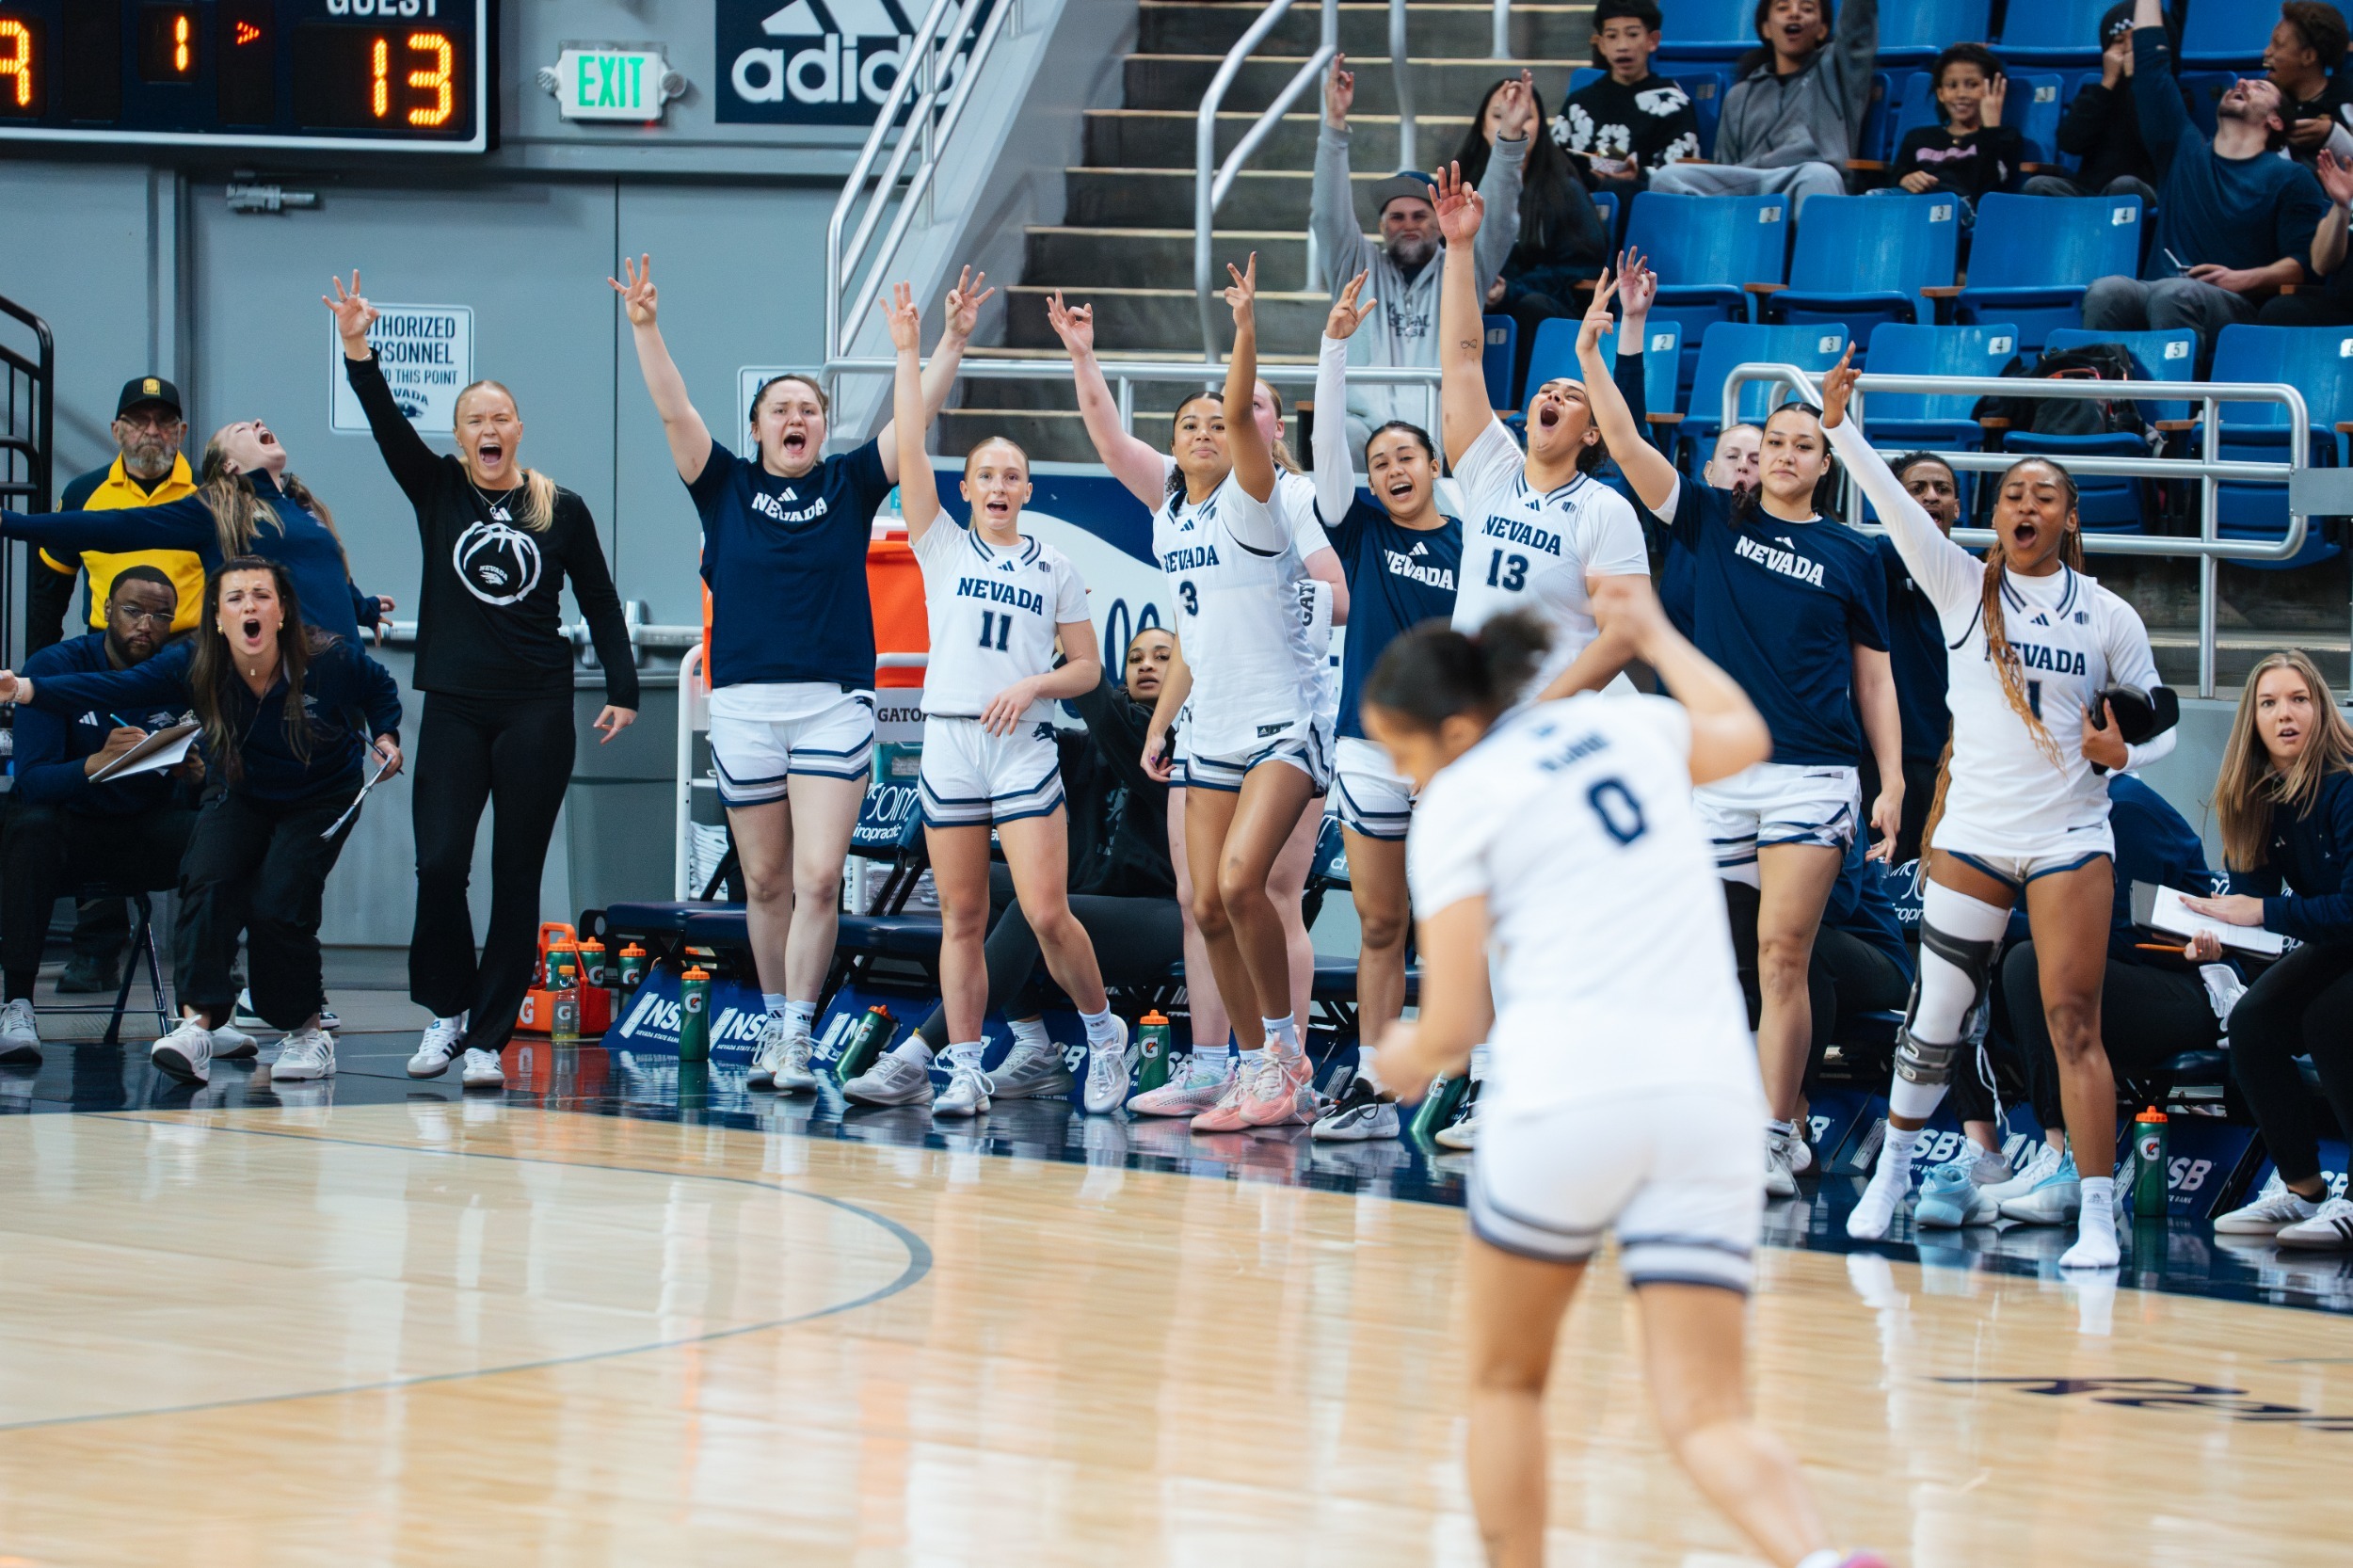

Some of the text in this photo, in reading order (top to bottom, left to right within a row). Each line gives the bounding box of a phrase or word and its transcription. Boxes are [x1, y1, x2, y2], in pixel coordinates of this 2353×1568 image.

[176, 15, 188, 72] 1
[374, 33, 453, 126] 13
[578, 56, 644, 108] EXIT
[1659, 335, 1668, 349] 2
[1826, 337, 1835, 351] 3
[1995, 339, 2004, 352] 4
[2173, 344, 2181, 358] 5
[395, 368, 421, 385] THIS
[424, 369, 458, 386] POINT
[392, 387, 429, 407] VADA
[751, 491, 828, 522] NEVADA
[1481, 514, 1561, 557] NEVADA
[1485, 546, 1530, 594] 13
[1735, 534, 1825, 588] NEVADA
[956, 576, 1044, 616] NEVADA
[1178, 579, 1199, 618] 3
[1298, 584, 1316, 627] GAT
[978, 607, 1014, 654] 11
[1585, 774, 1646, 846] 0
[853, 823, 902, 842] iropractic
[557, 1005, 571, 1020] G
[643, 999, 681, 1032] NS
[684, 992, 702, 1014] G
[1141, 1035, 1159, 1059] G
[1911, 1128, 1960, 1161] SB
[2139, 1136, 2160, 1161] G
[2168, 1156, 2213, 1192] SB
